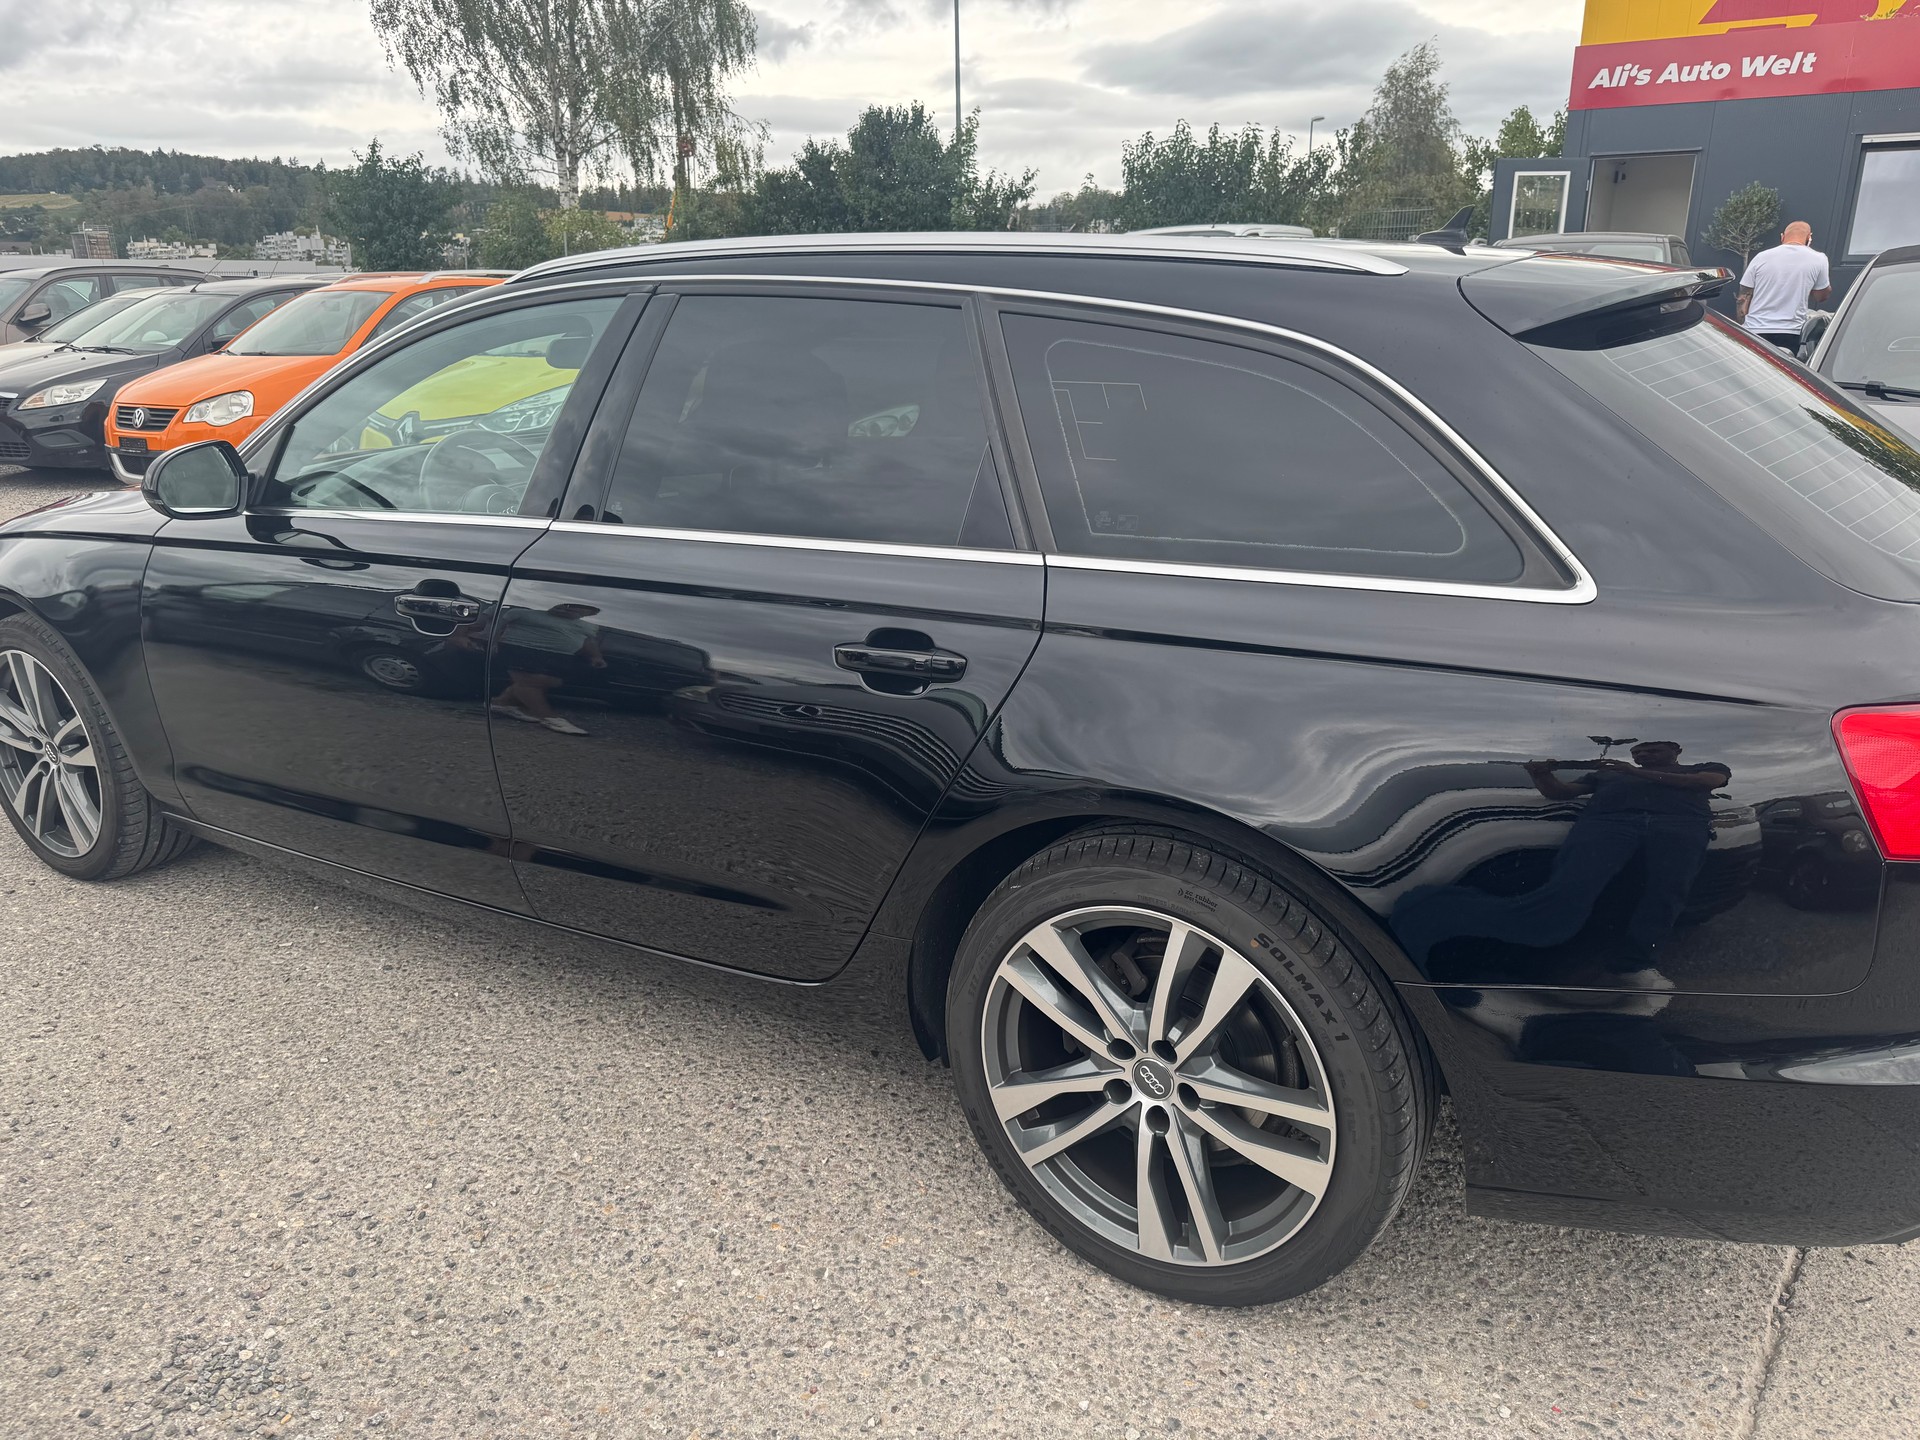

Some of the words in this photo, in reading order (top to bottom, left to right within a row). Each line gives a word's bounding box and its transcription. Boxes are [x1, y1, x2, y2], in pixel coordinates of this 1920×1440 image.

[1655, 60, 1731, 84] Auto
[1741, 51, 1817, 78] Welt
[1253, 932, 1338, 1025] SOLMAX
[1334, 1032, 1350, 1042] 1
